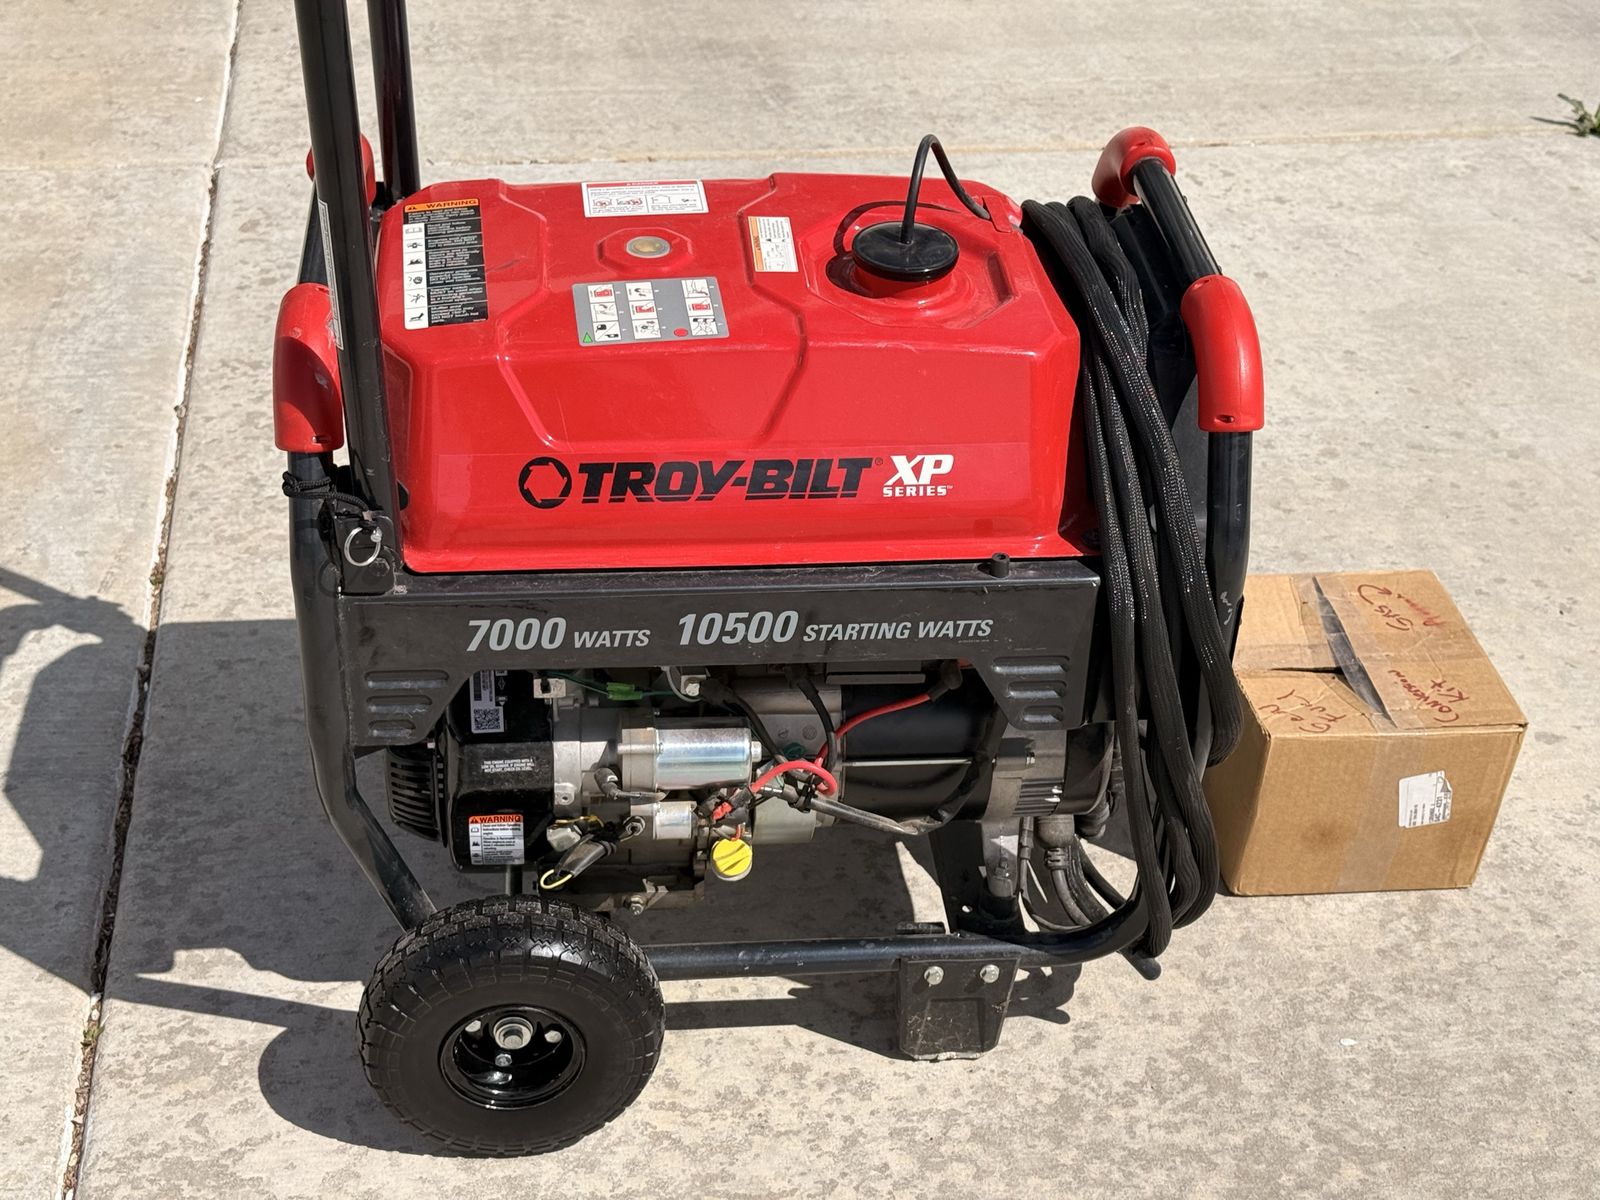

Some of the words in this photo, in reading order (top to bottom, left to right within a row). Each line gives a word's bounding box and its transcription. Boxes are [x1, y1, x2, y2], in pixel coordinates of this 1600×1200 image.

[426, 200, 478, 209] WARNING
[884, 454, 954, 486] XP
[882, 485, 948, 498] SERIES
[466, 617, 566, 652] 7000
[574, 629, 651, 649] WATTS
[678, 610, 799, 646] 10500
[803, 621, 912, 642] STARTING
[918, 619, 994, 638] WATTS
[480, 815, 521, 824] WARNING
